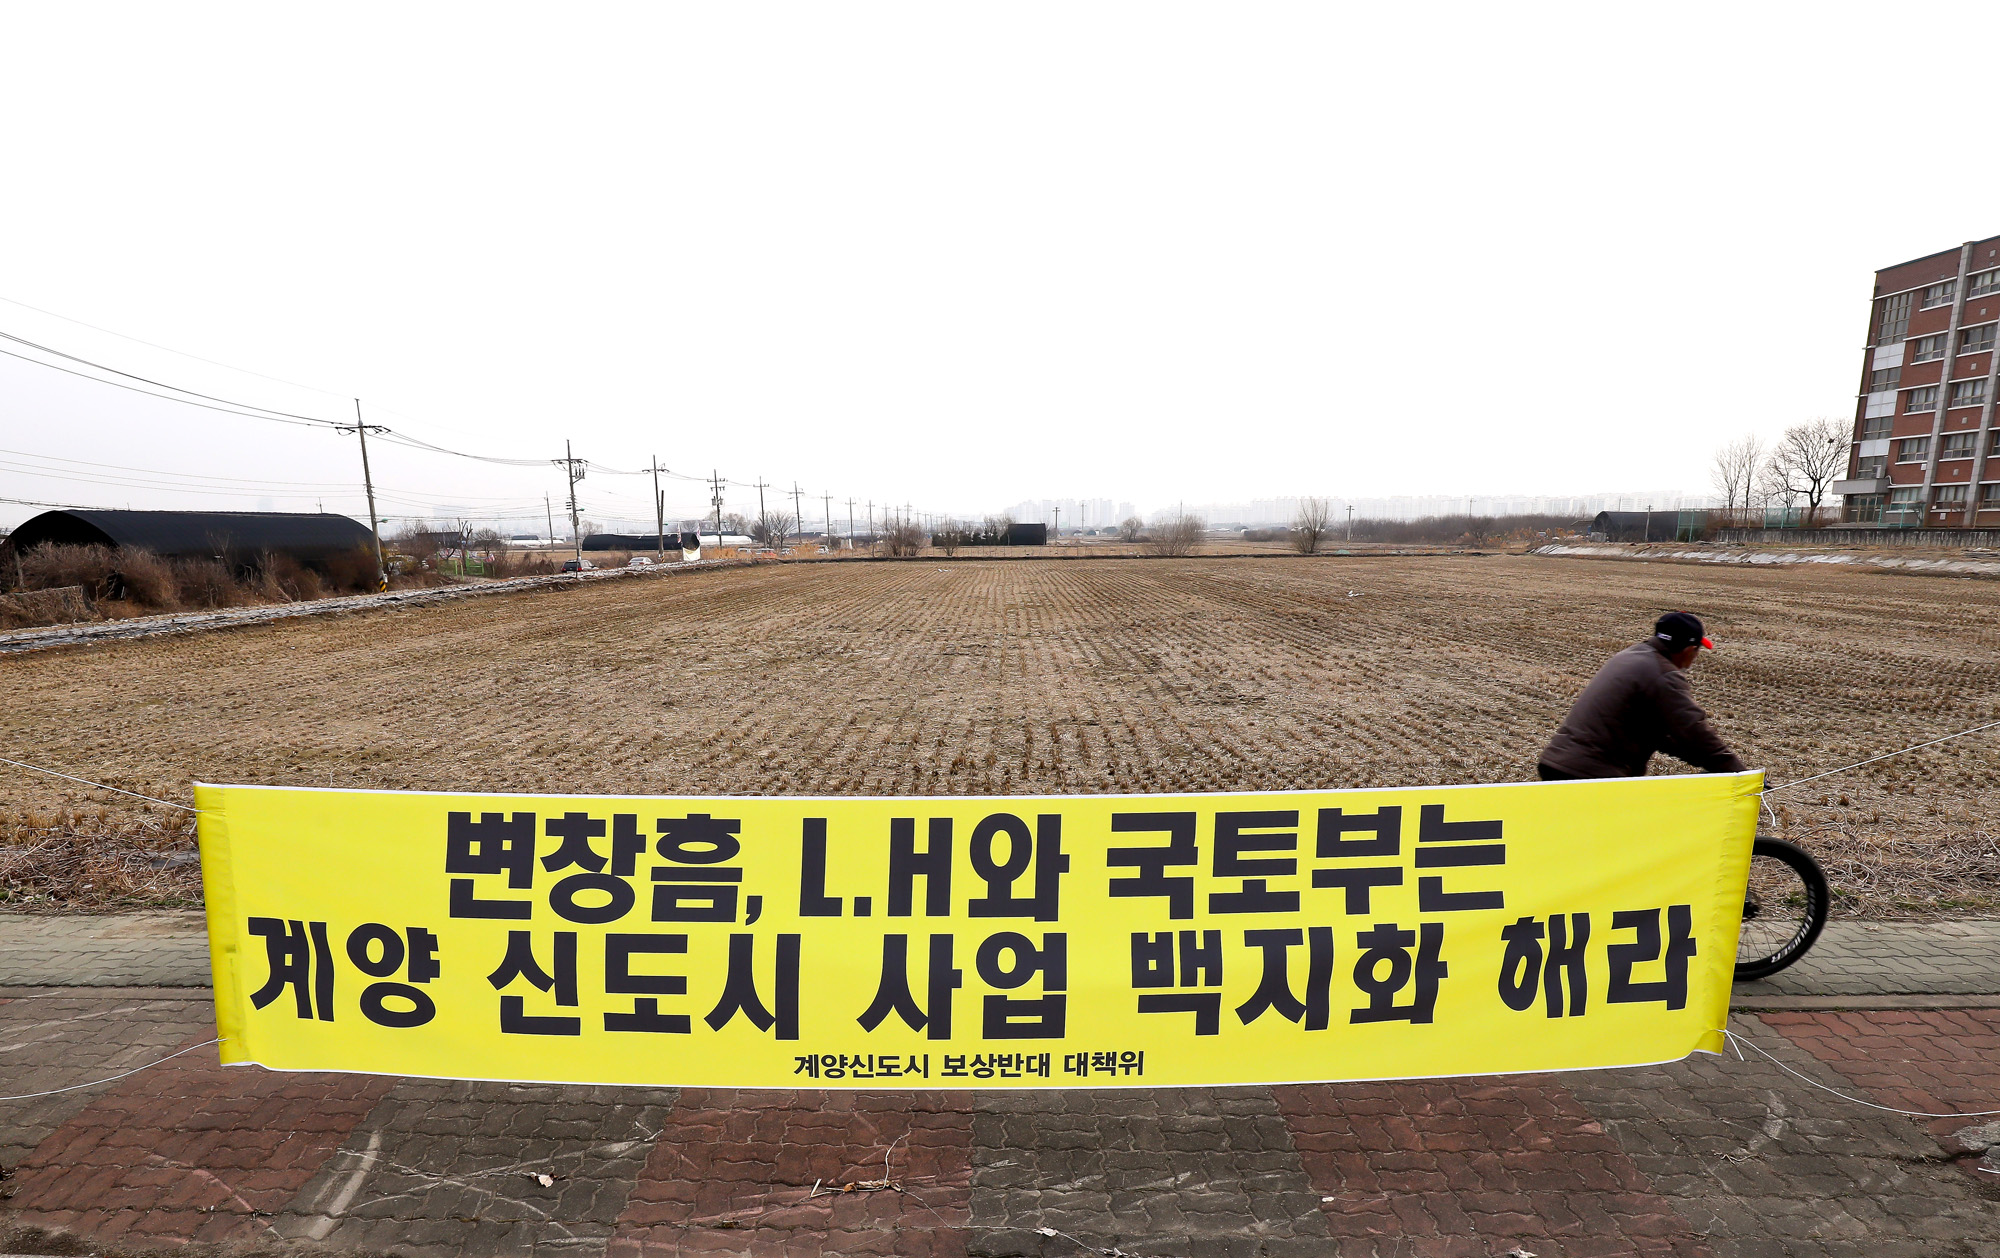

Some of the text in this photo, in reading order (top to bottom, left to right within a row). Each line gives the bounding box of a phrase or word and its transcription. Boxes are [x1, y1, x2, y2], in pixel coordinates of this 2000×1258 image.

[445, 804, 1506, 926] 변창흠, L.H와 국토부는
[247, 904, 1697, 1041] 계양 신도시 사업 백지화 해라
[793, 1050, 1145, 1079] 계양신도시 보상반대 대책위
